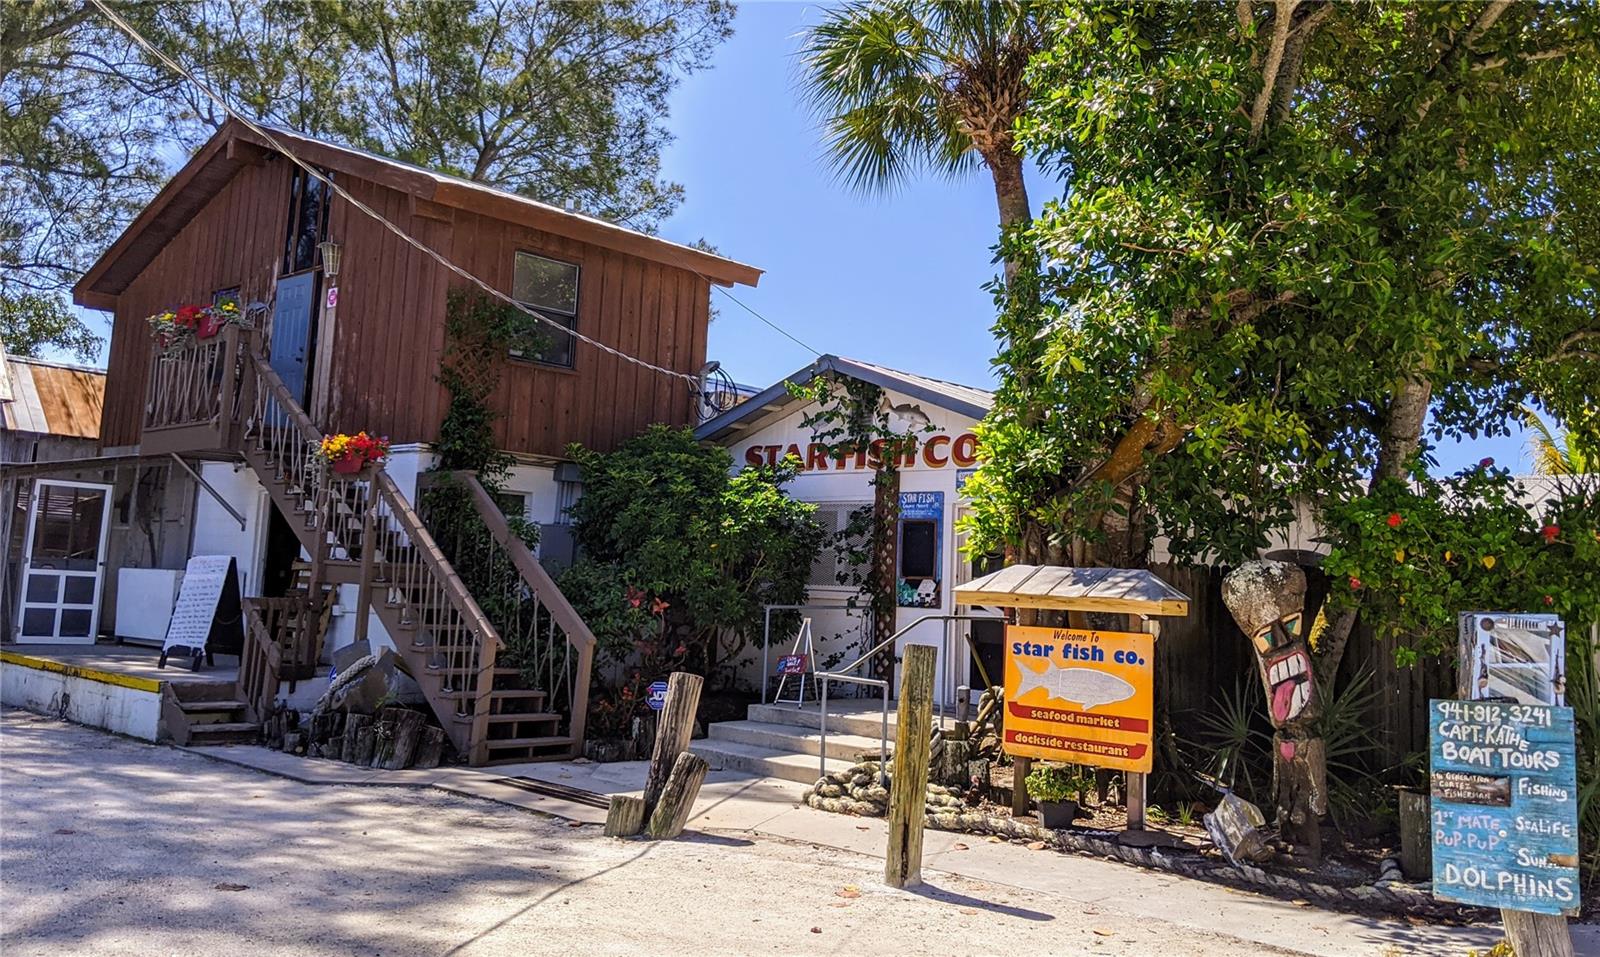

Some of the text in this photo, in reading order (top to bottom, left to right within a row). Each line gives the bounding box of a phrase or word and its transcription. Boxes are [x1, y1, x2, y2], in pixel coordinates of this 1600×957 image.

[745, 443, 828, 471] STAR
[918, 493, 935, 503] FISH
[1053, 630, 1100, 643] Welcome To
[1012, 641, 1145, 665] star fish co.
[1031, 709, 1120, 728] seafood market
[1437, 702, 1551, 726] 941-812-3241
[1015, 733, 1129, 757] dockside restaurant
[1442, 741, 1560, 771] BOAT TOURS
[1457, 815, 1500, 830] MATE
